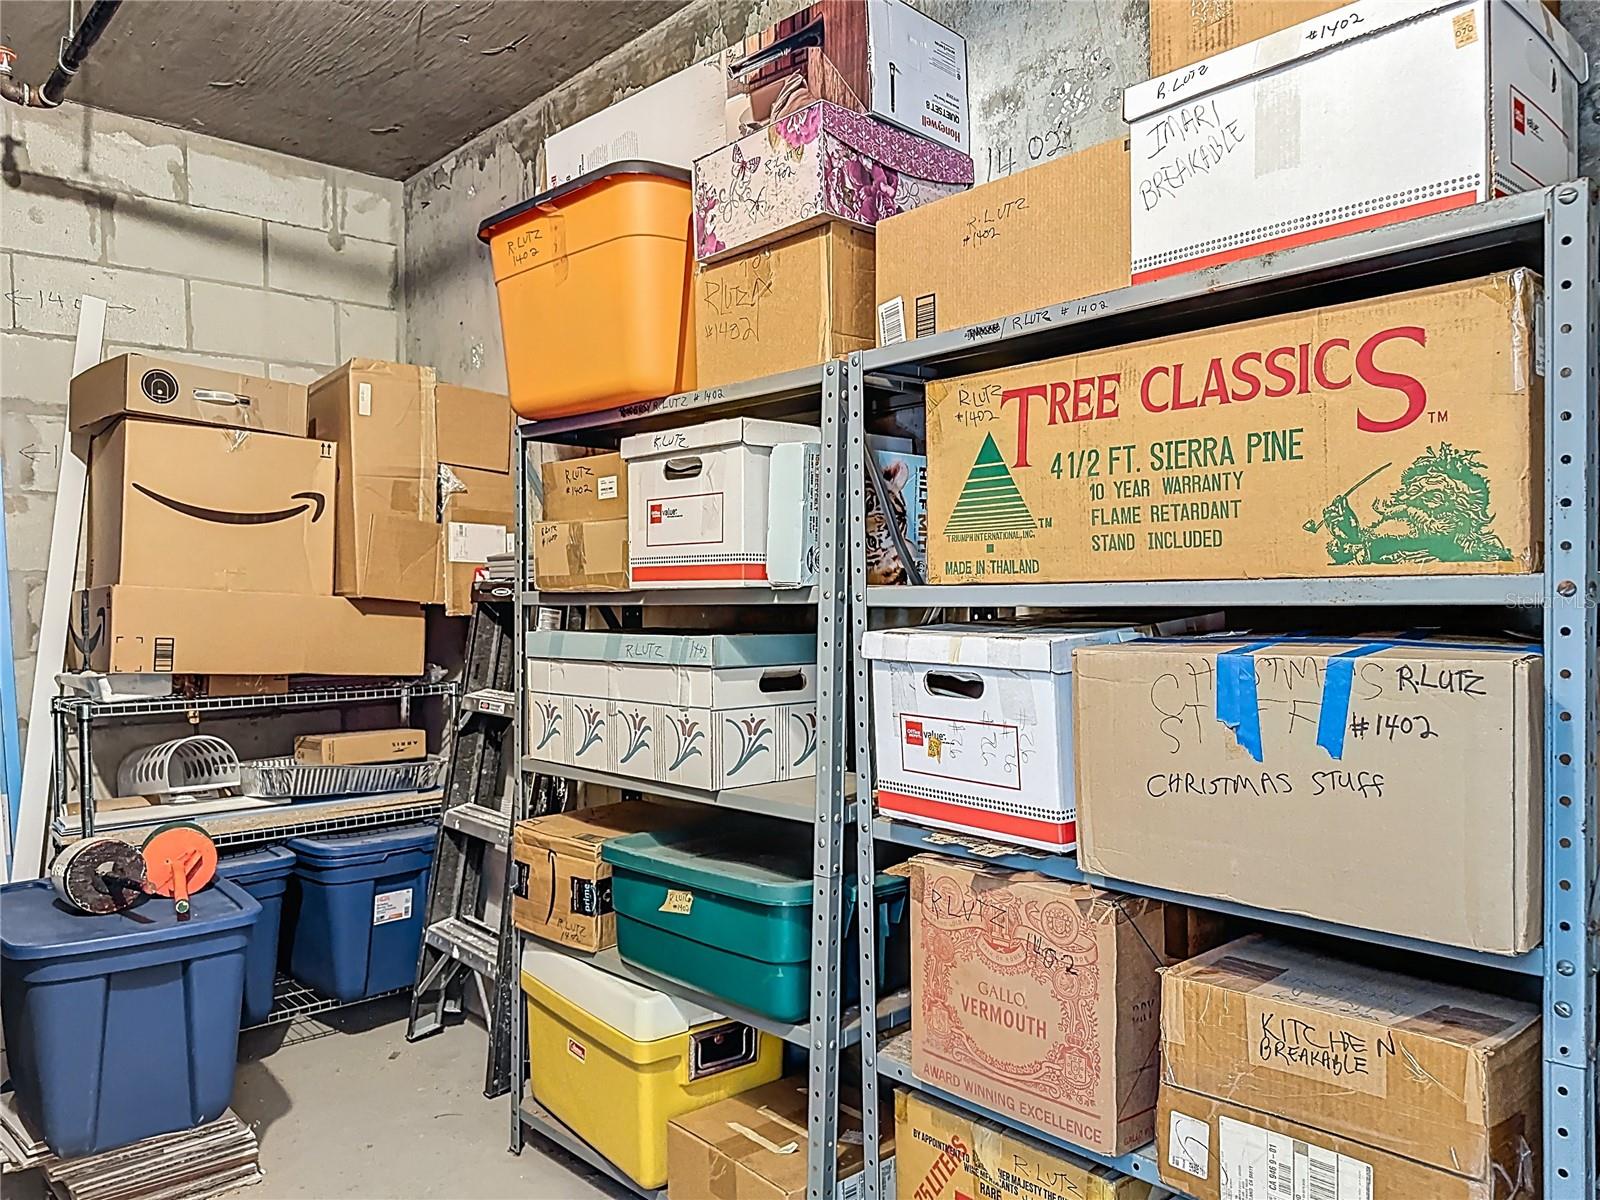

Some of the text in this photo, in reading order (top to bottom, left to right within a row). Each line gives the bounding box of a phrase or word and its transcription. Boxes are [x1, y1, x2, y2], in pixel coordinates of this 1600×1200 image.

[1305, 13, 1365, 41] #1402
[922, 115, 961, 143] Honeywell
[1147, 100, 1221, 159] IMARI
[1139, 119, 1245, 212] BREAKABLE
[962, 228, 1001, 247] #1402
[513, 247, 540, 266] 1402
[1000, 326, 1428, 469] TREE CLASSICS
[1108, 444, 1141, 475] FT.
[1150, 436, 1235, 472] SIERRA
[1247, 427, 1304, 464] PINE
[1089, 470, 1244, 501] 10 YEAR WARRANTY
[1091, 500, 1242, 526] FLAME RETARDANT
[1091, 529, 1223, 552] STAND INCLUDED
[945, 559, 1040, 576] MADE IN THAILAND
[1348, 714, 1438, 740] #1402
[1146, 772, 1293, 799] CHRISTMAS
[583, 883, 591, 912] prime
[960, 993, 1048, 1041] VERMOUTH
[1260, 1041, 1369, 1076] BREAKABLE
[922, 1063, 1103, 1145] AWARD WINNING EXCELLENCE
[913, 1128, 921, 1140] BY
[921, 1132, 962, 1160] APPOINTMENT
[1011, 1173, 1045, 1195] MAJESTY
[1269, 1180, 1277, 1191] CA
